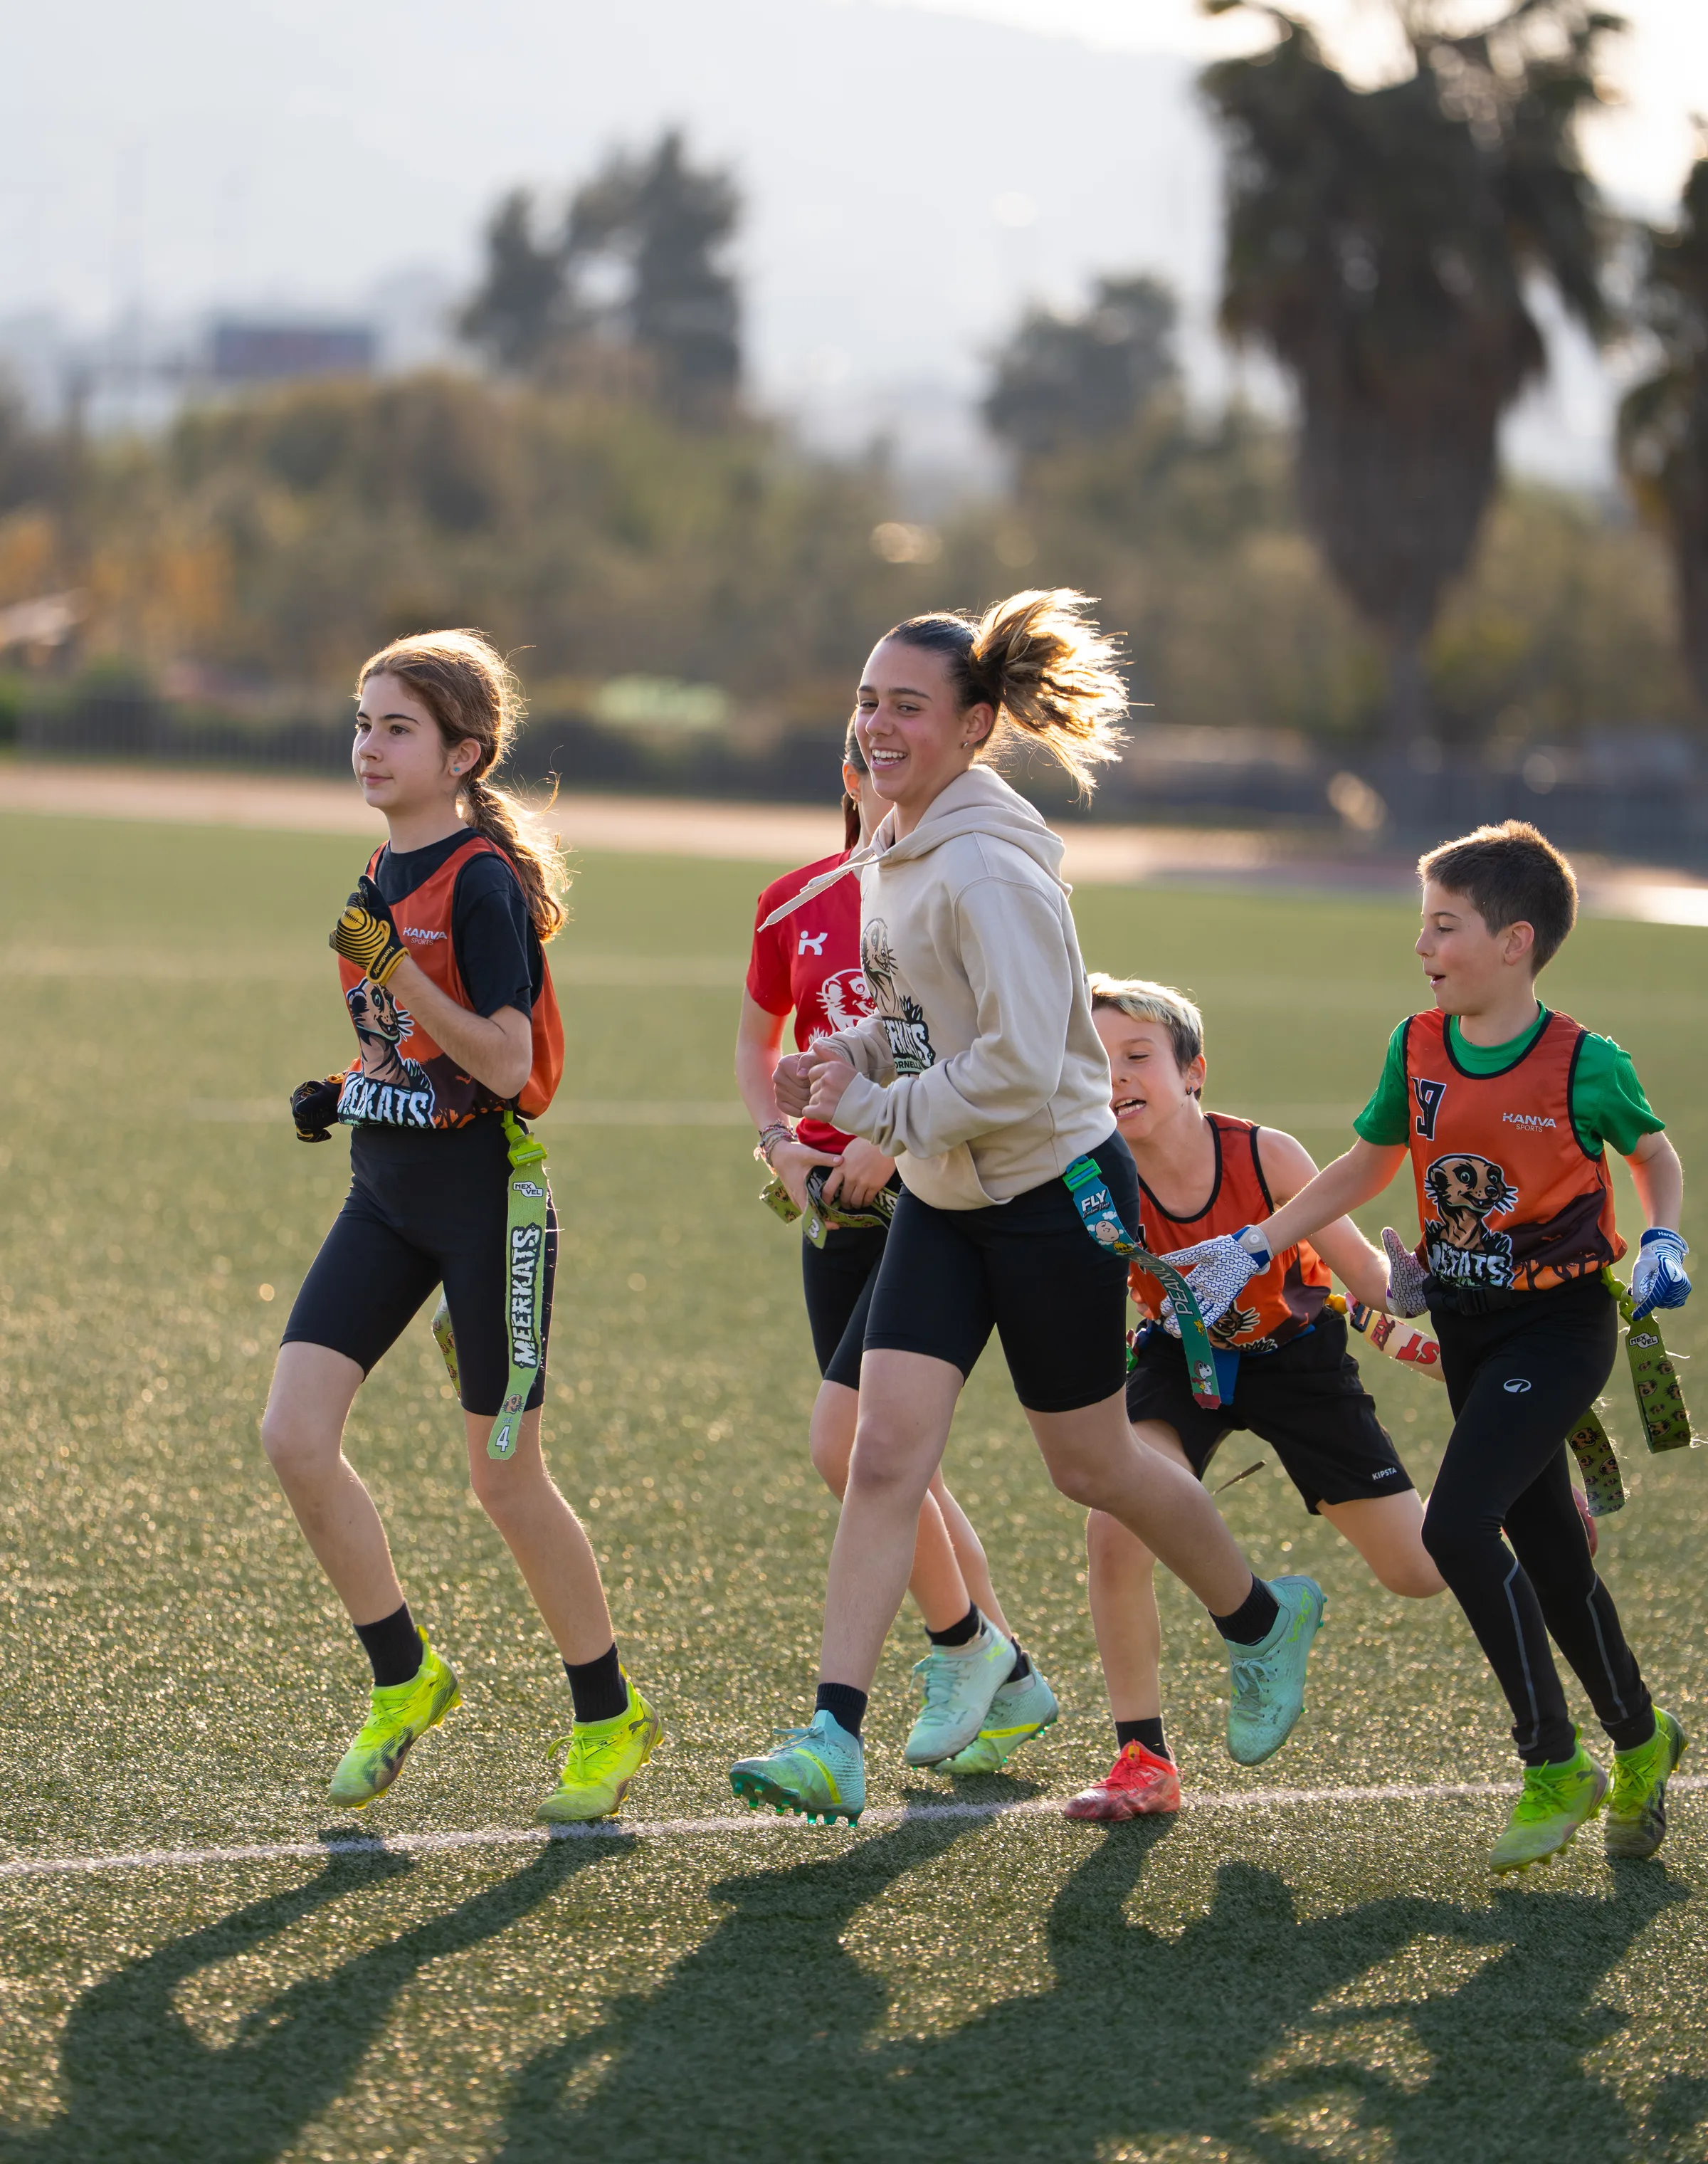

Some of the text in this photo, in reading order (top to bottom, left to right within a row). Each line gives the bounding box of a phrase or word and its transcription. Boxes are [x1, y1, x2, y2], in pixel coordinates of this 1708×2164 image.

[402, 927, 448, 940] KANVA
[373, 945, 395, 975] Handlandy
[1502, 1112, 1557, 1128] KANVA
[1516, 1123, 1543, 1133] SPORTS
[1081, 1189, 1107, 1212] FLY
[510, 1225, 542, 1367] MEERKATS
[1370, 1313, 1388, 1348] FLY
[1630, 1335, 1646, 1345] NEX
[495, 1425, 511, 1452] 4
[1371, 1466, 1398, 1481] KIPSTA
